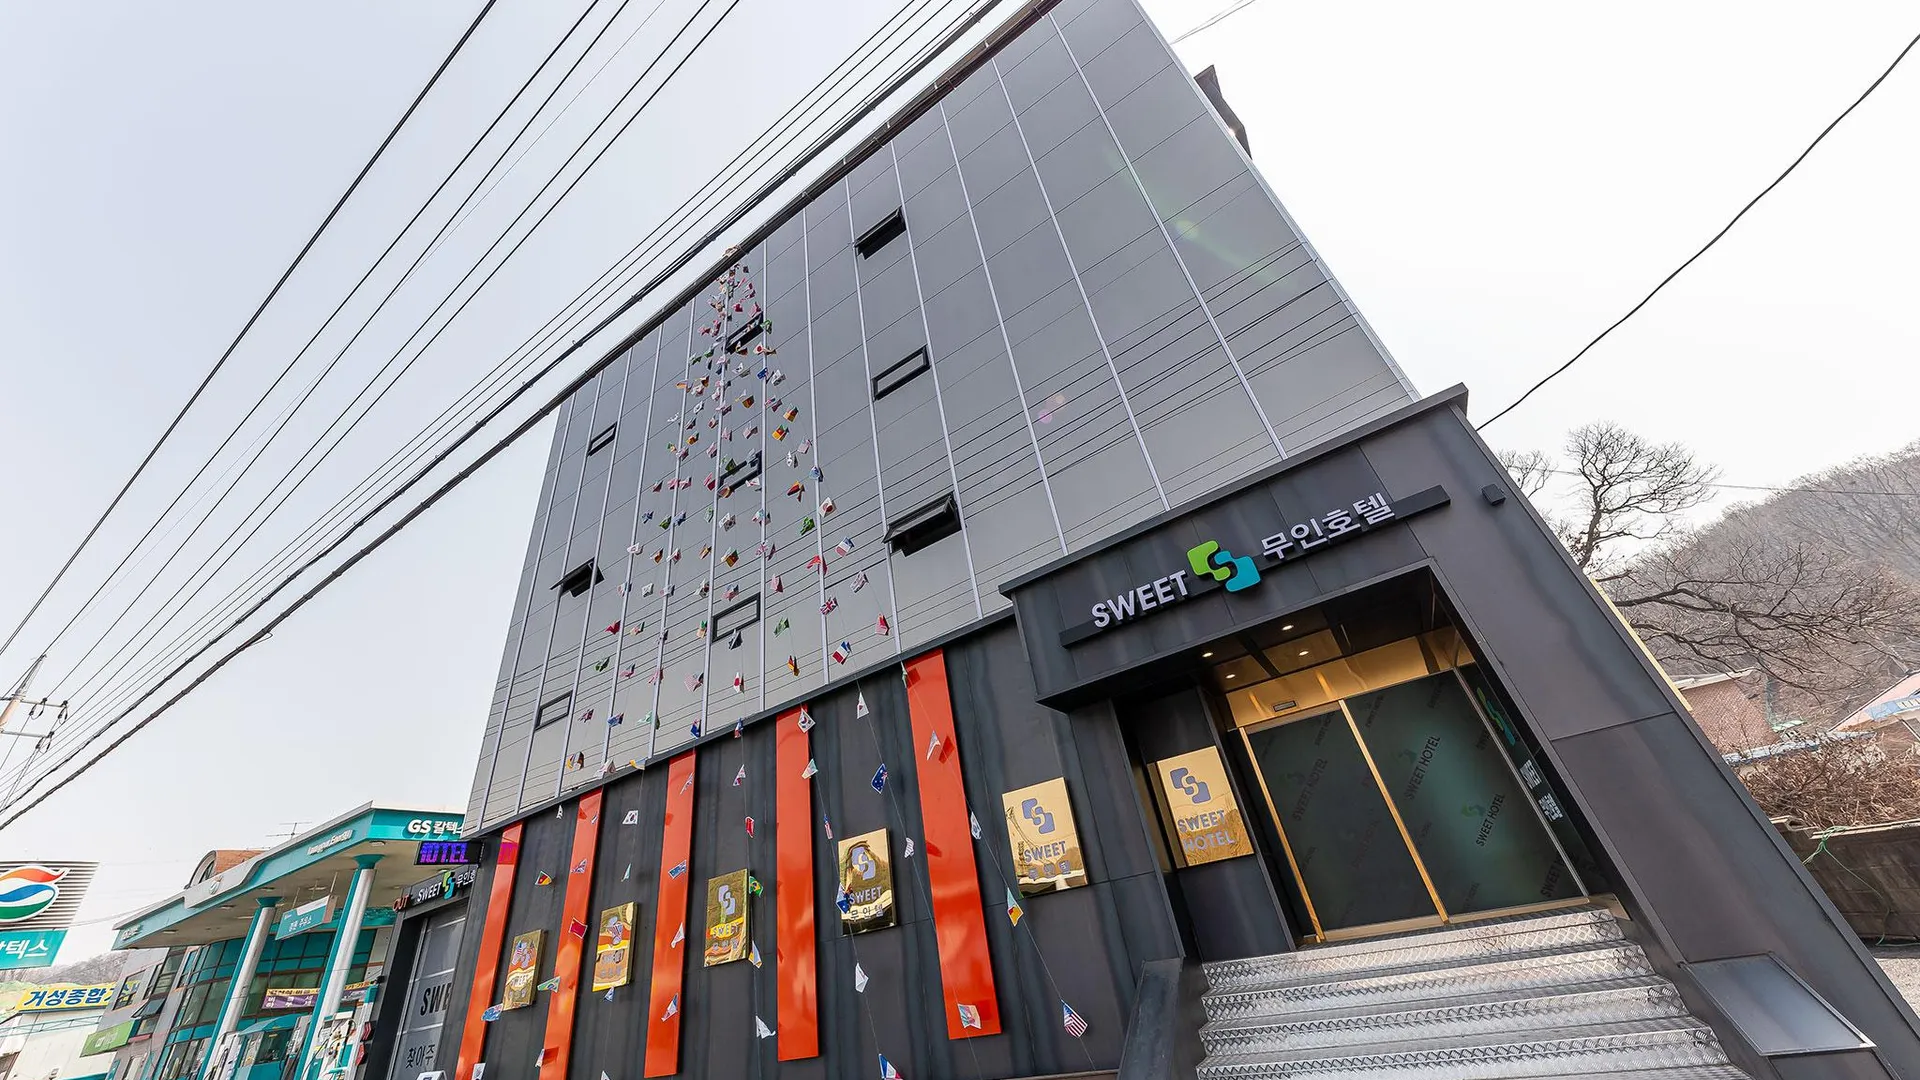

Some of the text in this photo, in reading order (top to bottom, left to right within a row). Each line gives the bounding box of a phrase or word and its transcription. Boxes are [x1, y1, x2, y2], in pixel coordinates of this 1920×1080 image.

[1090, 492, 1396, 629] SWEET 무인호텔
[1403, 765, 1427, 801] SWEET
[1418, 736, 1441, 767] HOTEL
[407, 819, 432, 834] GS
[1177, 809, 1225, 833] SWEET
[1475, 793, 1505, 847] SWEET HOTEL
[1024, 840, 1066, 863] SWEET
[1183, 829, 1235, 851] HOTEL
[392, 894, 410, 912] OUT
[416, 881, 442, 902] SWEET
[848, 885, 882, 905] SWEET
[850, 903, 884, 922] 무인텔
[24, 983, 140, 1007] 거성종합
[405, 1044, 436, 1069] 찾아주
